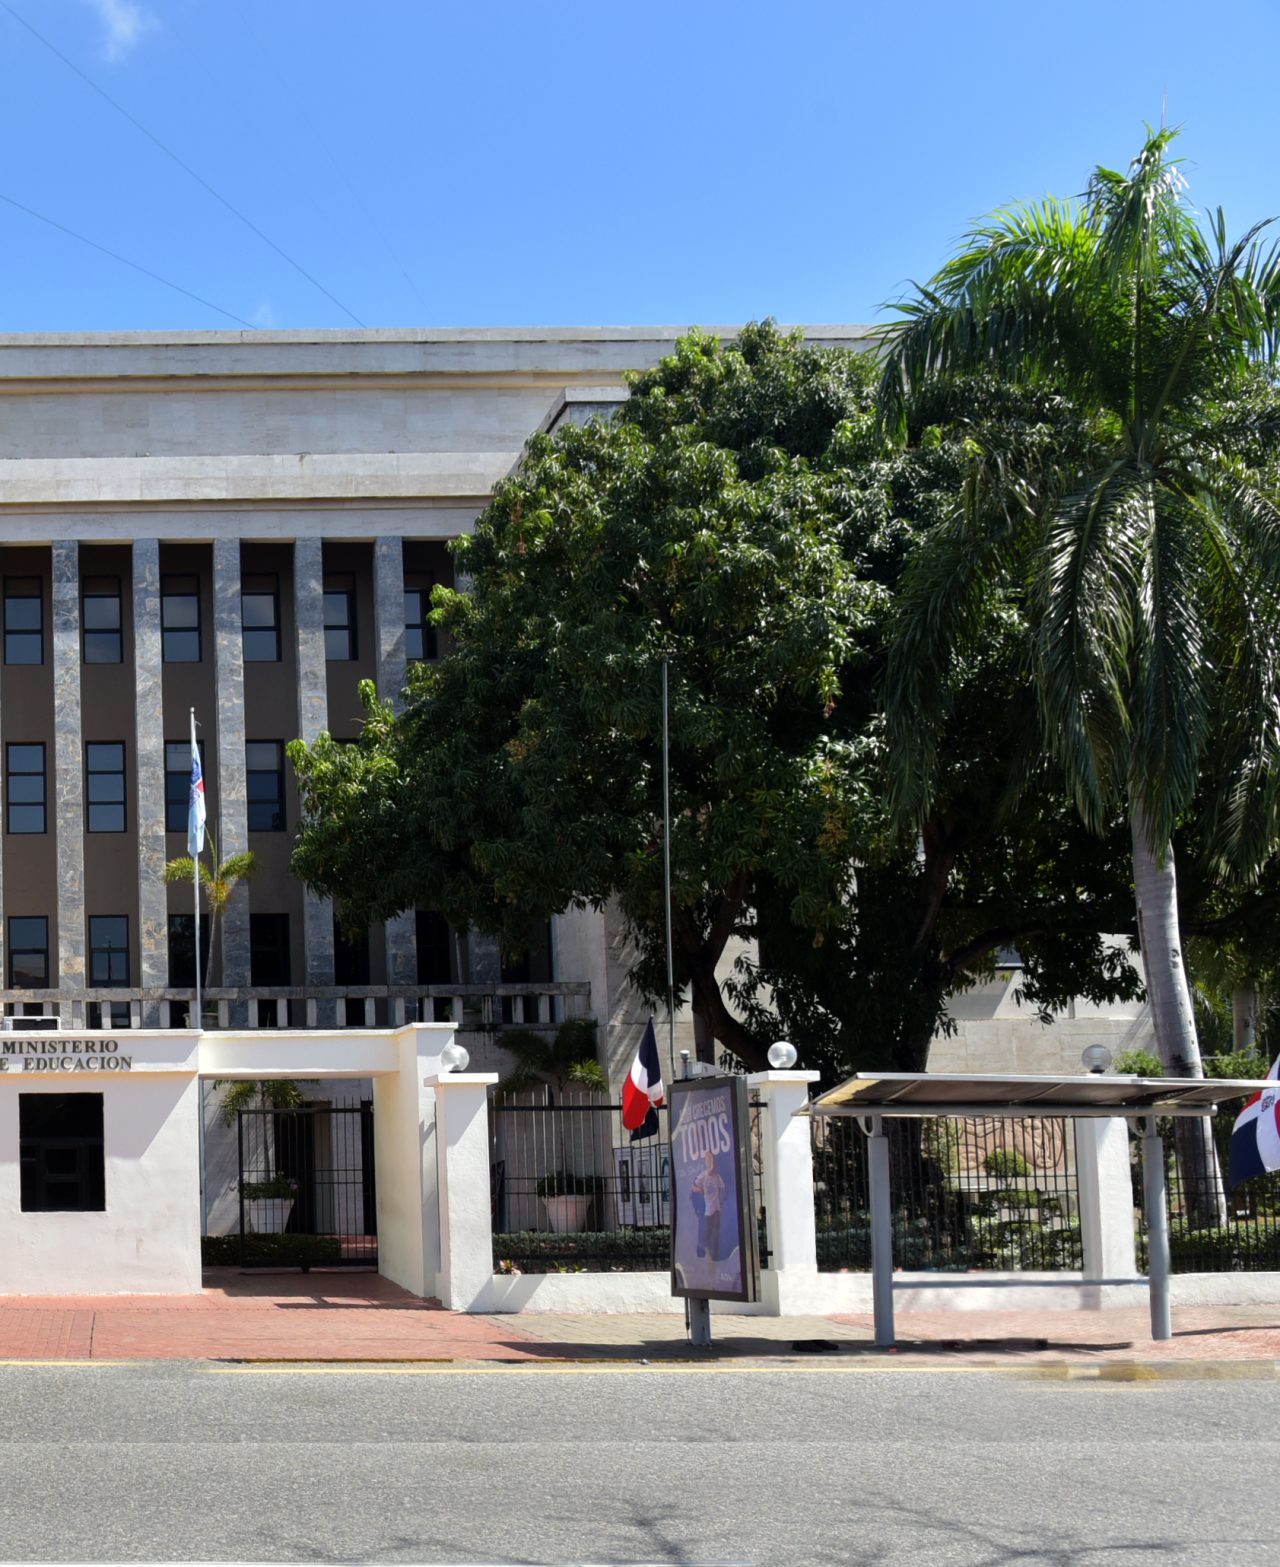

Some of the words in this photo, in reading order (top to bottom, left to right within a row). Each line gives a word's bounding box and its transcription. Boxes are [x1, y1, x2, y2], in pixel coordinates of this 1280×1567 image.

[2, 1040, 119, 1055] MINISTERIO
[24, 1056, 133, 1071] EDUCACION
[678, 1112, 730, 1164] TODOS
